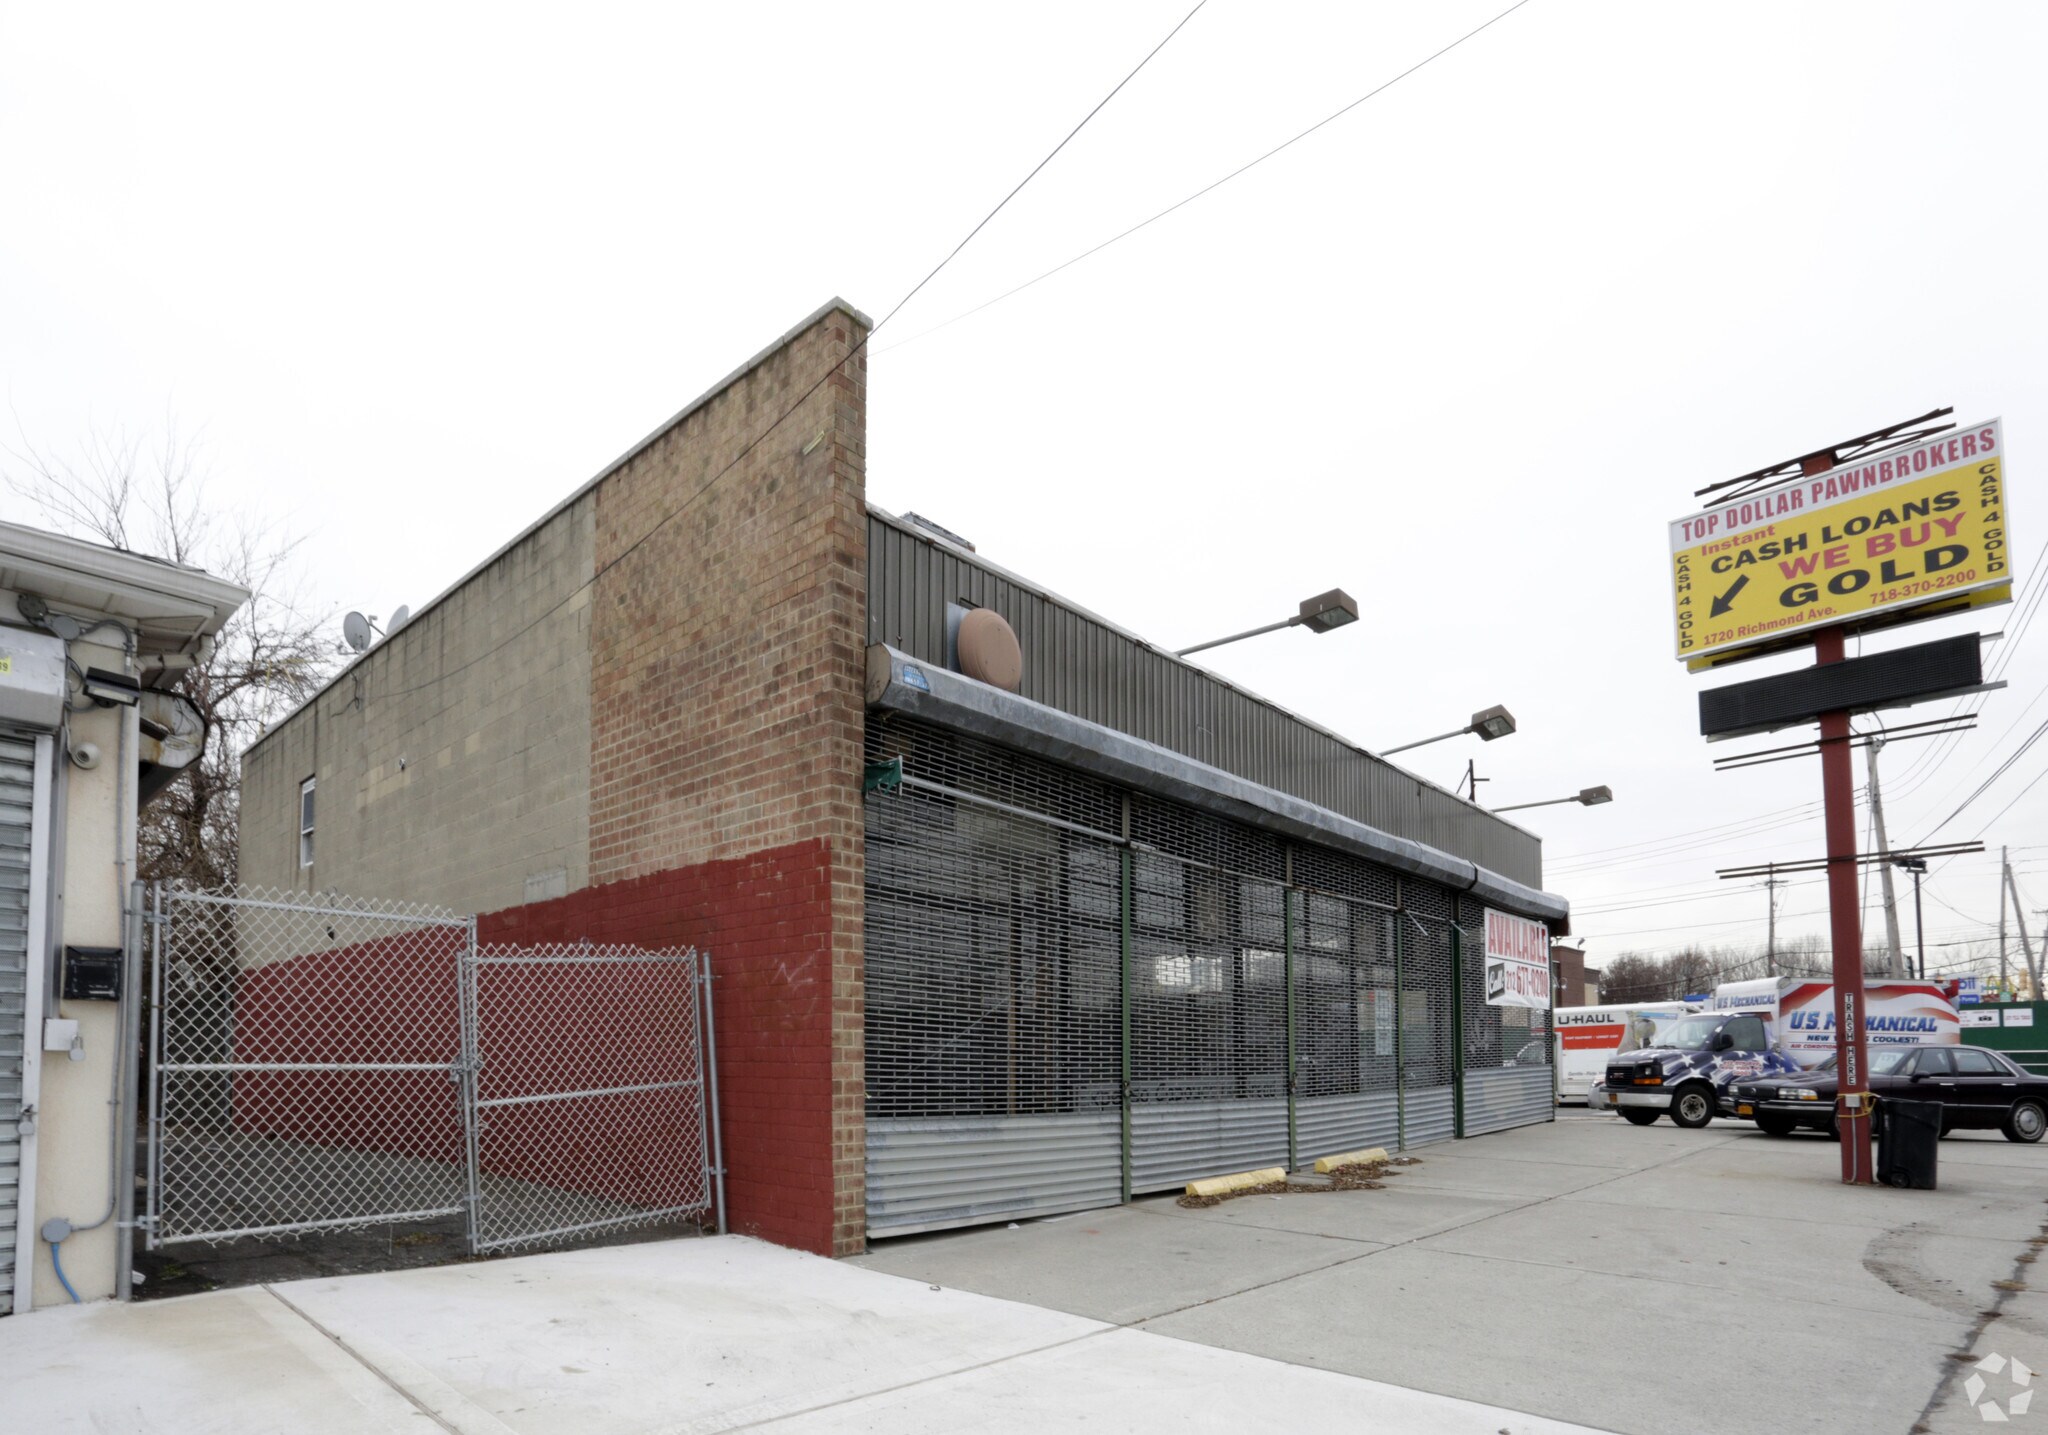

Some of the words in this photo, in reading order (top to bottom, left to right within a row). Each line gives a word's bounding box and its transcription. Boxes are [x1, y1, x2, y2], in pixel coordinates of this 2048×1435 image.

[1682, 514, 1718, 542] TOP
[1726, 489, 1803, 530] DOLLAR
[1812, 428, 1995, 503] PAWNBROKERS
[1978, 464, 1999, 508] CASH
[1711, 533, 1808, 573] CASH
[1822, 491, 1960, 544] LOANS
[1983, 511, 2000, 523] 4
[1701, 525, 1776, 556] Instant
[1778, 544, 1850, 580] WE
[1866, 512, 1967, 559] BUY
[1983, 529, 2004, 573] GOLD
[1677, 555, 1691, 593] CASH
[1779, 544, 1969, 608] GOLD
[1870, 569, 1976, 604] 718-370-2200
[1679, 596, 1691, 606] 4
[1679, 611, 1694, 649] GOLD
[1703, 629, 1733, 646] 1720
[1738, 612, 1804, 637] Richmond
[1808, 606, 1837, 620] Ave.
[1488, 913, 1547, 964] AVAILABLE
[1506, 971, 1516, 990] 212
[1558, 1014, 1615, 1025] U-HAUL
[1790, 1011, 1821, 1031] U.S.
[1824, 1012, 1938, 1032] MHANICAL
[1846, 993, 1854, 1041] TRASH
[1872, 1036, 1920, 1044] COOLEST!
[1848, 1047, 1856, 1085] HERE
